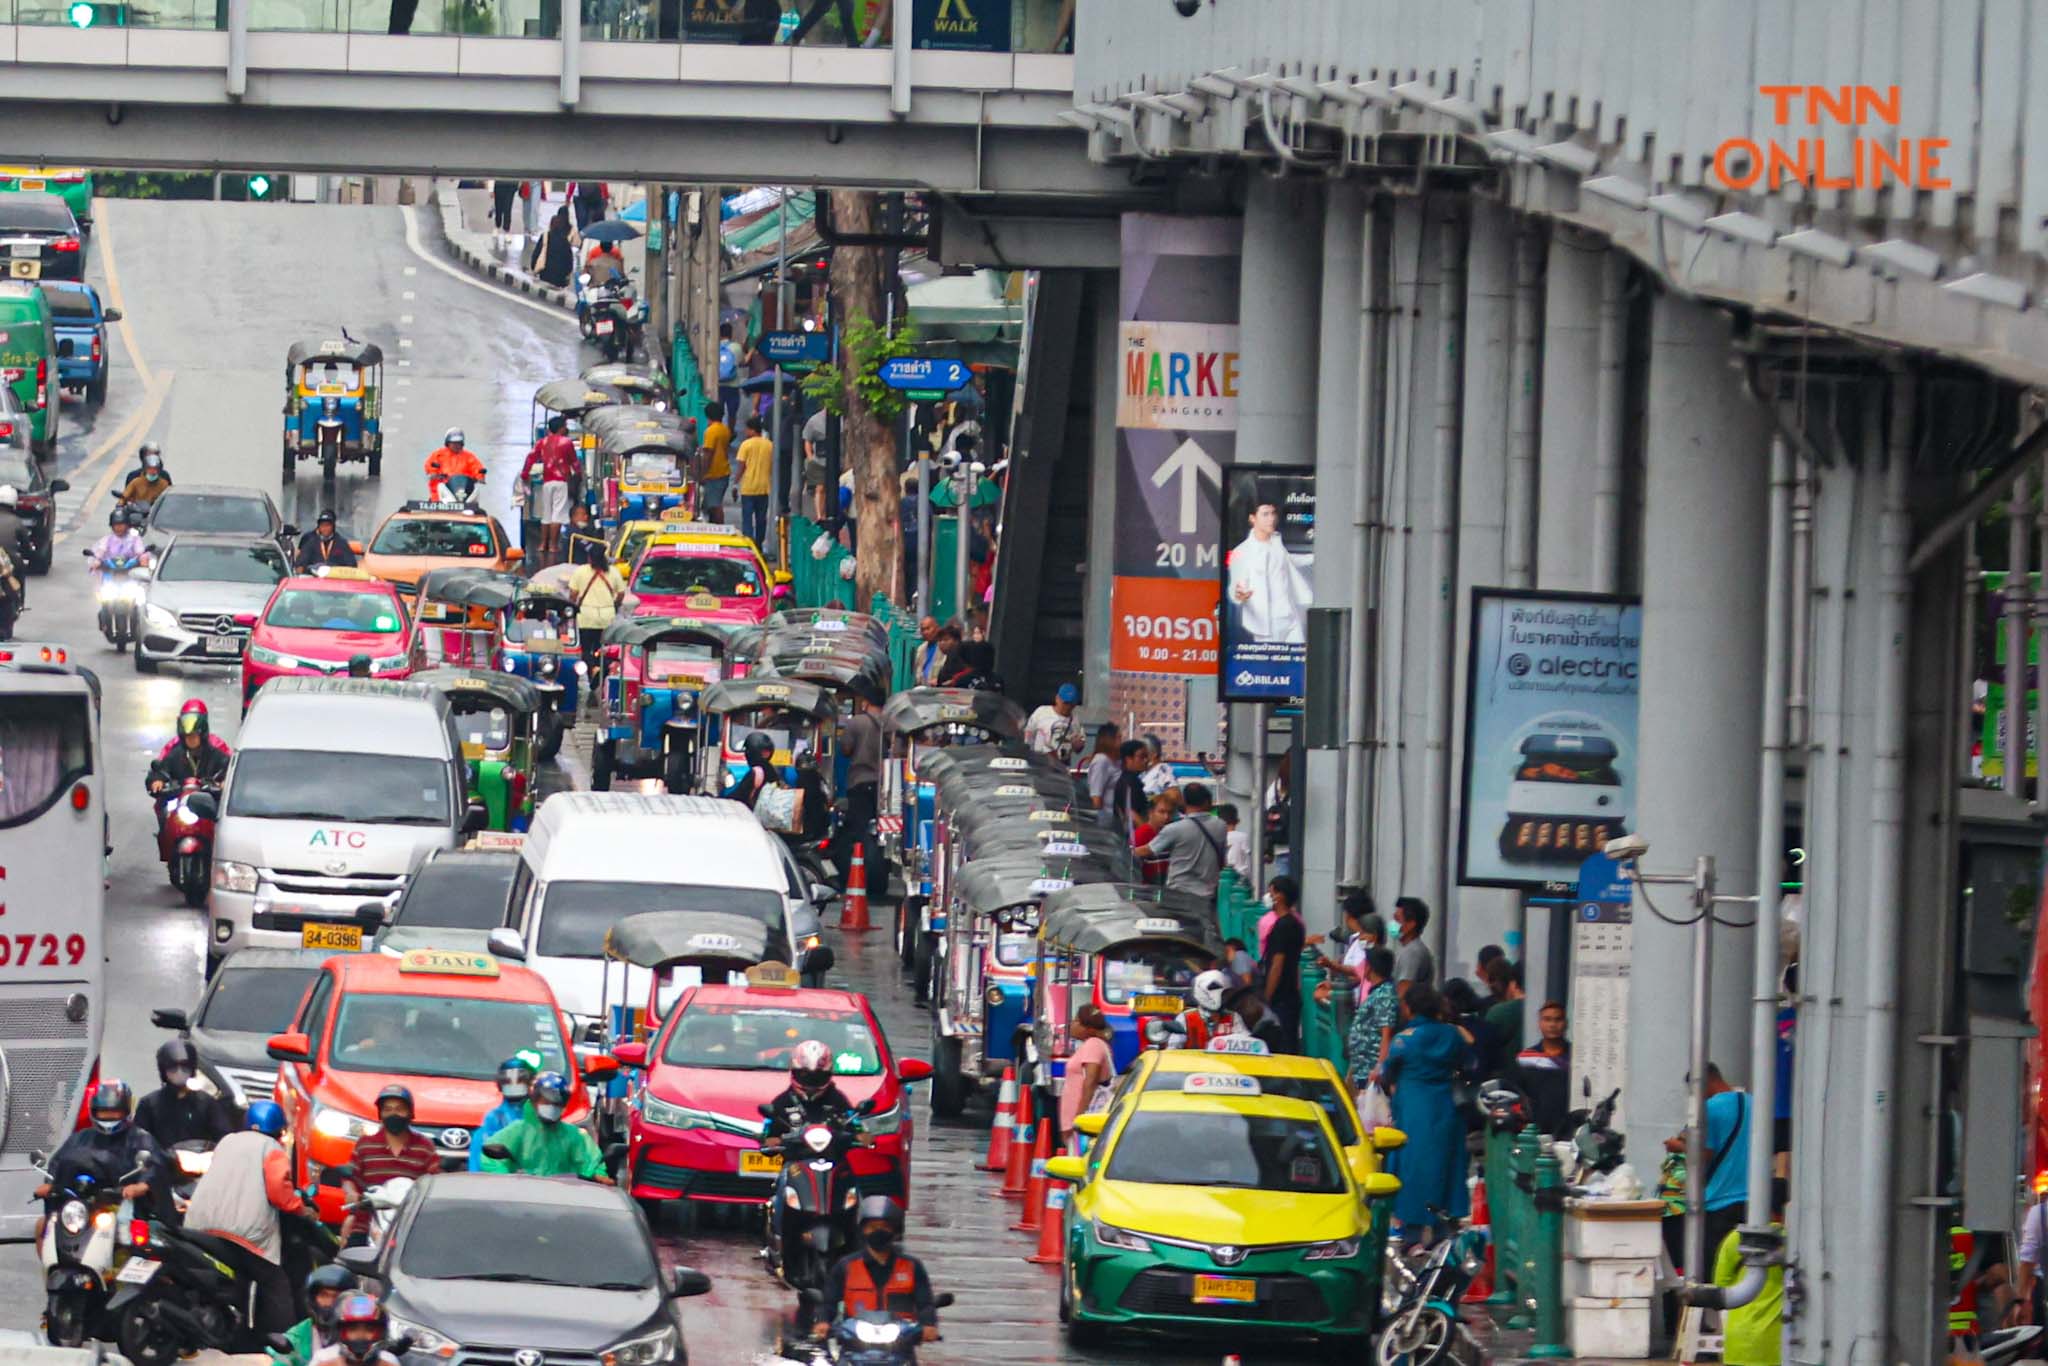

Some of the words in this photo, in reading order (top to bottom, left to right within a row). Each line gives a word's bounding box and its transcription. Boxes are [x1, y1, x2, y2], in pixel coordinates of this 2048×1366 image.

[934, 19, 978, 33] WALK
[1127, 337, 1145, 348] THE
[948, 364, 961, 381] 2
[1155, 542, 1187, 568] 20
[1195, 543, 1219, 569] M
[1538, 655, 1639, 680] alectric
[309, 829, 367, 849] ATC
[431, 956, 474, 968] TAXI
[1227, 1039, 1251, 1052] TAXI
[1207, 1077, 1240, 1088] TAXI
